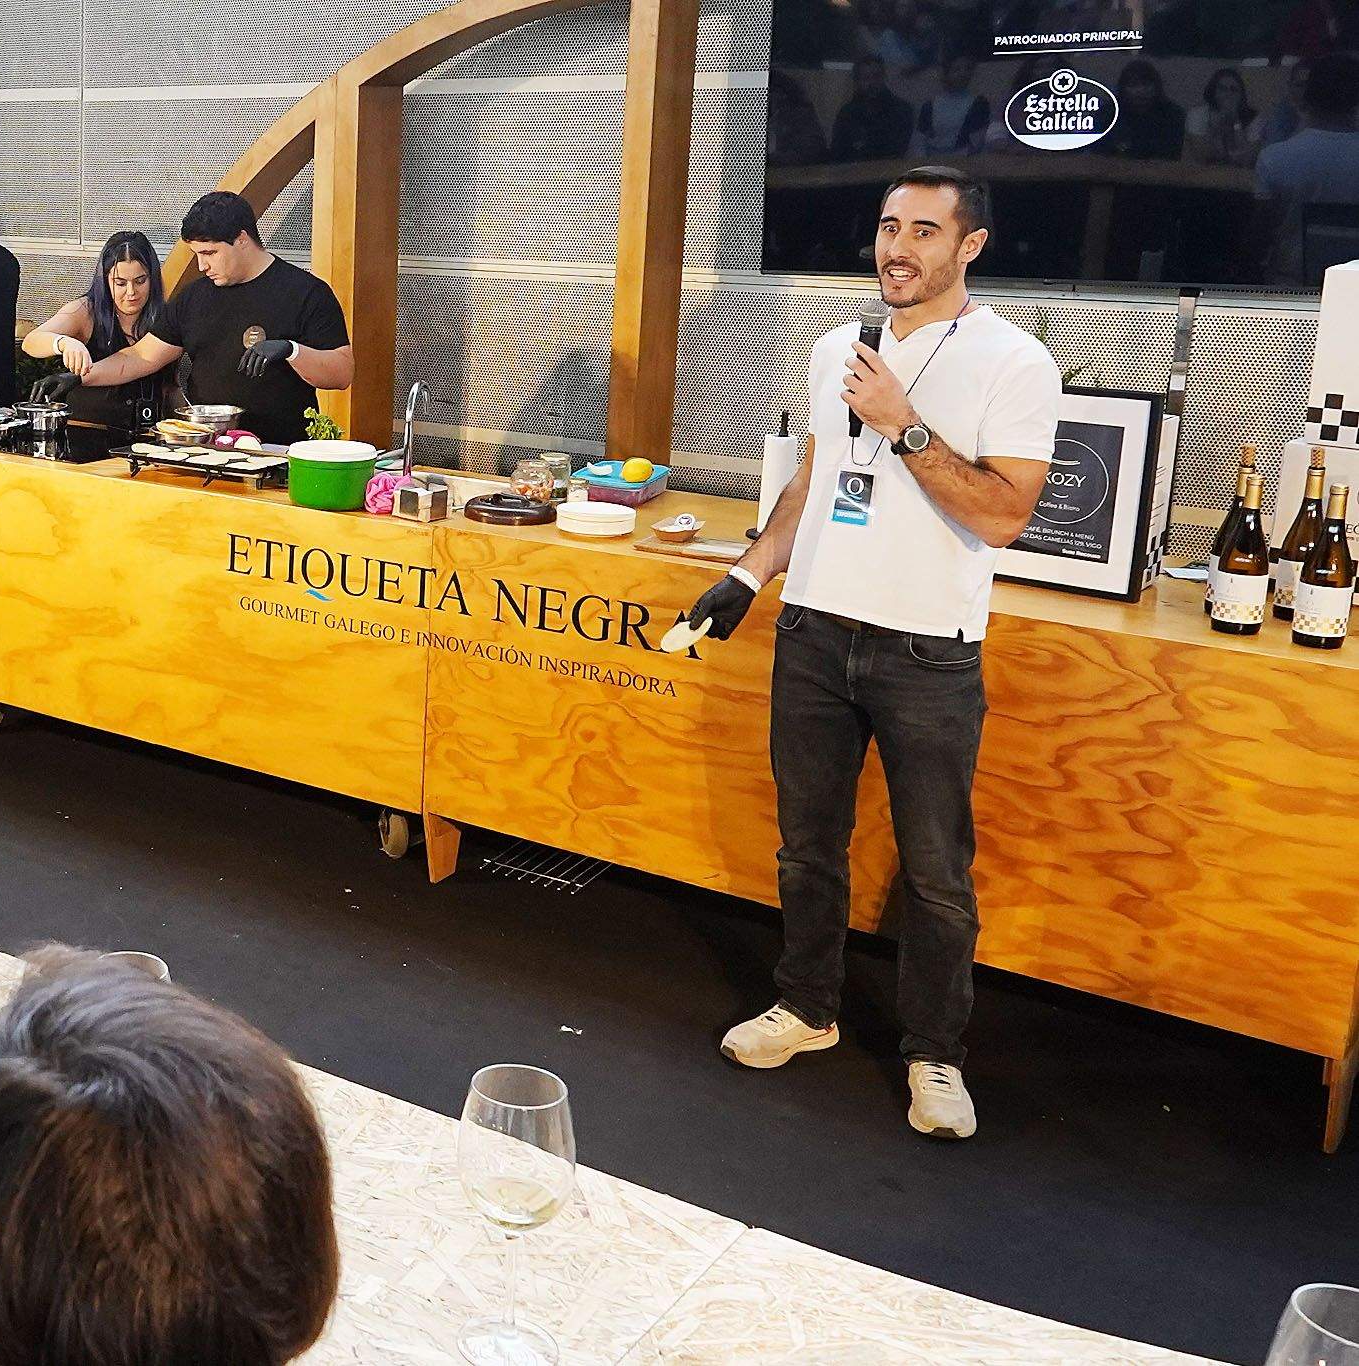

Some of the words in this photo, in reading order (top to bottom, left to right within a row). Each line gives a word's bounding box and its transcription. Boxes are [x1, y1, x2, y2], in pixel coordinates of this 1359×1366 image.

[994, 32, 1081, 46] PATROCINADOR
[1082, 30, 1143, 42] PRINCIPAL
[1023, 93, 1100, 112] Estrella
[1025, 111, 1094, 131] Galicia
[1029, 533, 1042, 541] DAS
[1042, 527, 1069, 536] BRUNCH
[226, 532, 472, 617] ETIQUETA
[239, 596, 320, 626] GOURMET
[324, 613, 396, 641] GALEGO
[400, 629, 411, 644] E
[416, 631, 533, 668] INNOVACIÓN
[537, 655, 678, 697] INSPIRADORA
